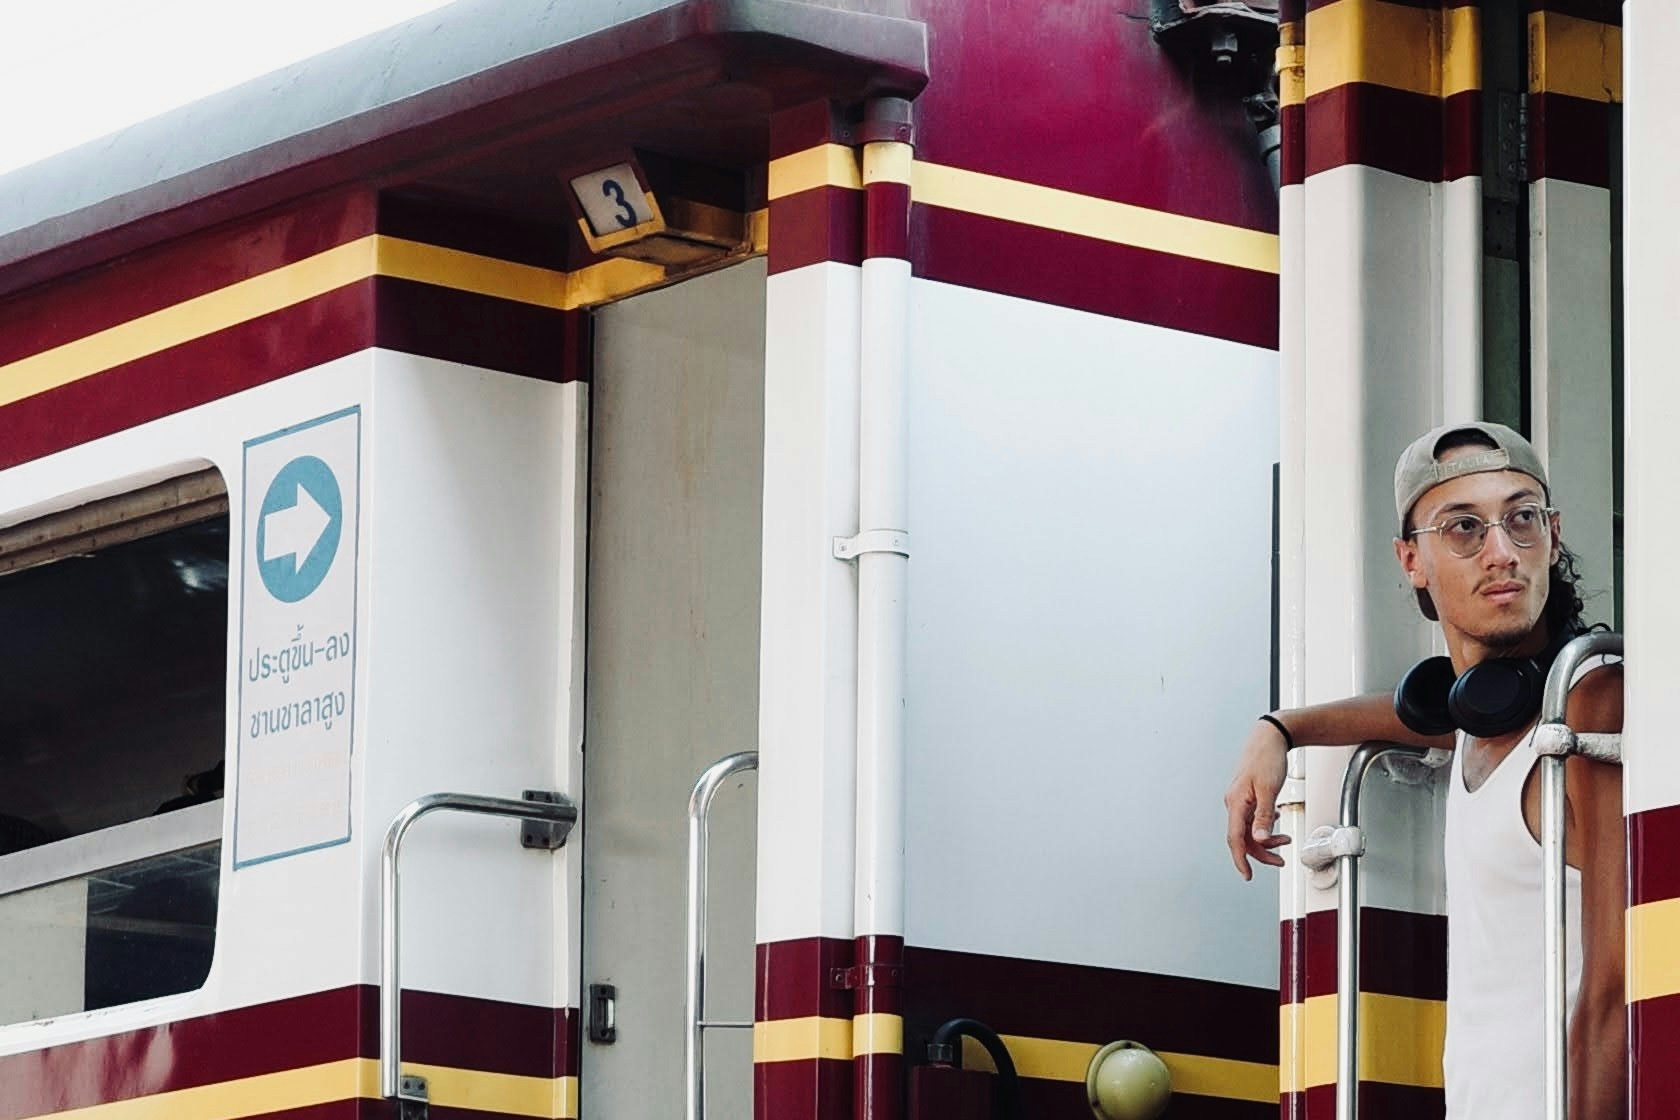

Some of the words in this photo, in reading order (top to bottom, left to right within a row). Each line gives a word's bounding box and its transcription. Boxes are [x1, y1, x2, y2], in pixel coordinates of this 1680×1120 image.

[602, 178, 638, 229] 3
[249, 623, 351, 684] ประตูขึ้น-ลง
[250, 691, 346, 739] ชานชาลาสูง
